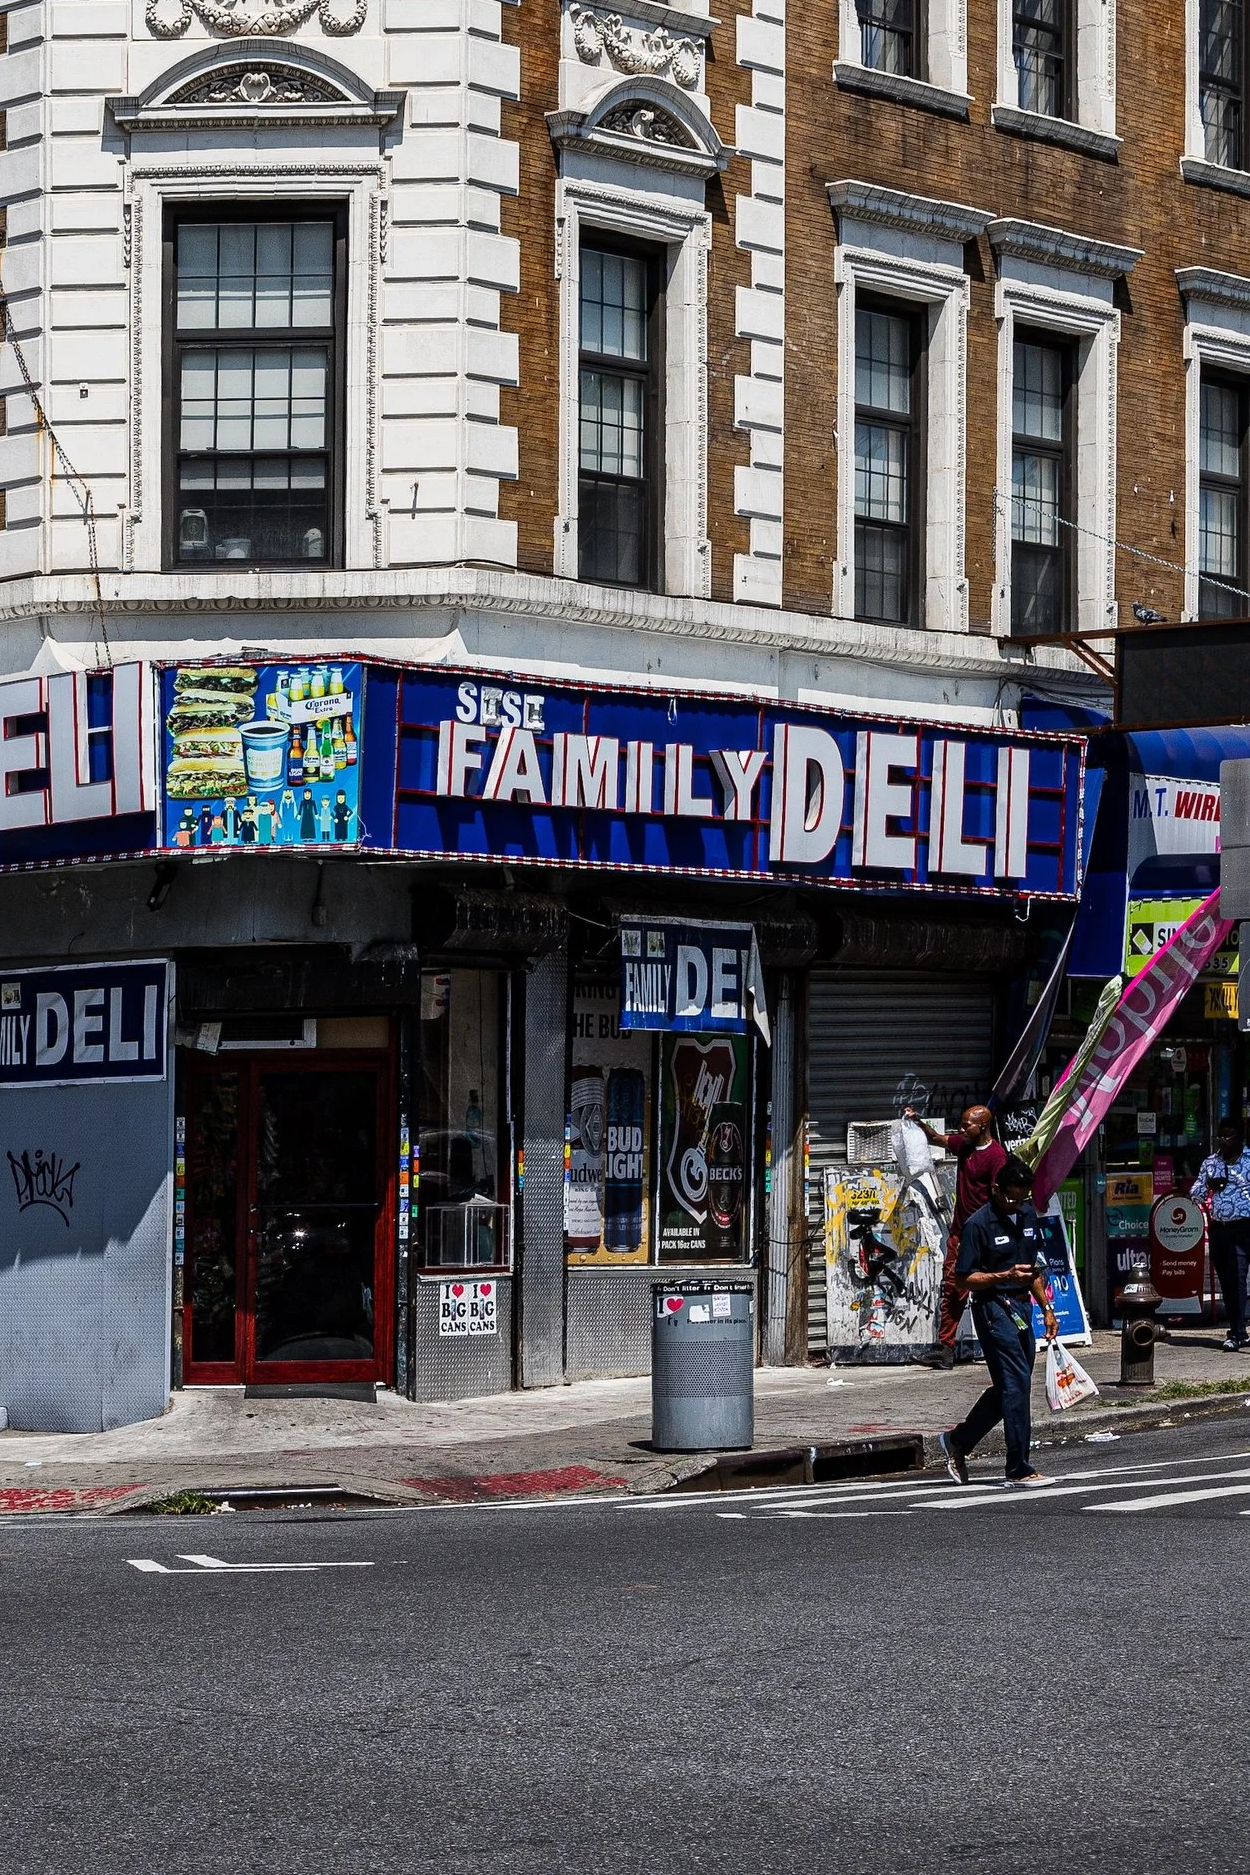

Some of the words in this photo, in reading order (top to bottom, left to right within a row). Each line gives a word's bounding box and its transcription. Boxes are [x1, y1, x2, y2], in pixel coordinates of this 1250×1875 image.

[305, 698, 341, 711] Corona
[437, 720, 769, 821] FAMILY
[769, 723, 1031, 878] DELI
[625, 962, 672, 1013] FAMILY
[36, 984, 158, 1066] DELI
[607, 1126, 643, 1152] BUD
[709, 1166, 743, 1181] BECK'S
[1114, 1178, 1139, 1195] Ria
[1118, 1219, 1149, 1230] Choice
[1159, 1225, 1199, 1234] MoneyGram
[662, 1227, 693, 1237] AVAILABLE
[693, 1227, 700, 1236] IN
[661, 1240, 677, 1249] PACK
[677, 1239, 690, 1249] 16oz
[690, 1239, 706, 1249] CANS
[1162, 1259, 1177, 1267] Send
[1177, 1260, 1197, 1268] money
[445, 1284, 451, 1299] I
[472, 1284, 478, 1299] I
[441, 1322, 467, 1333] CANS
[470, 1320, 495, 1332] CANS
